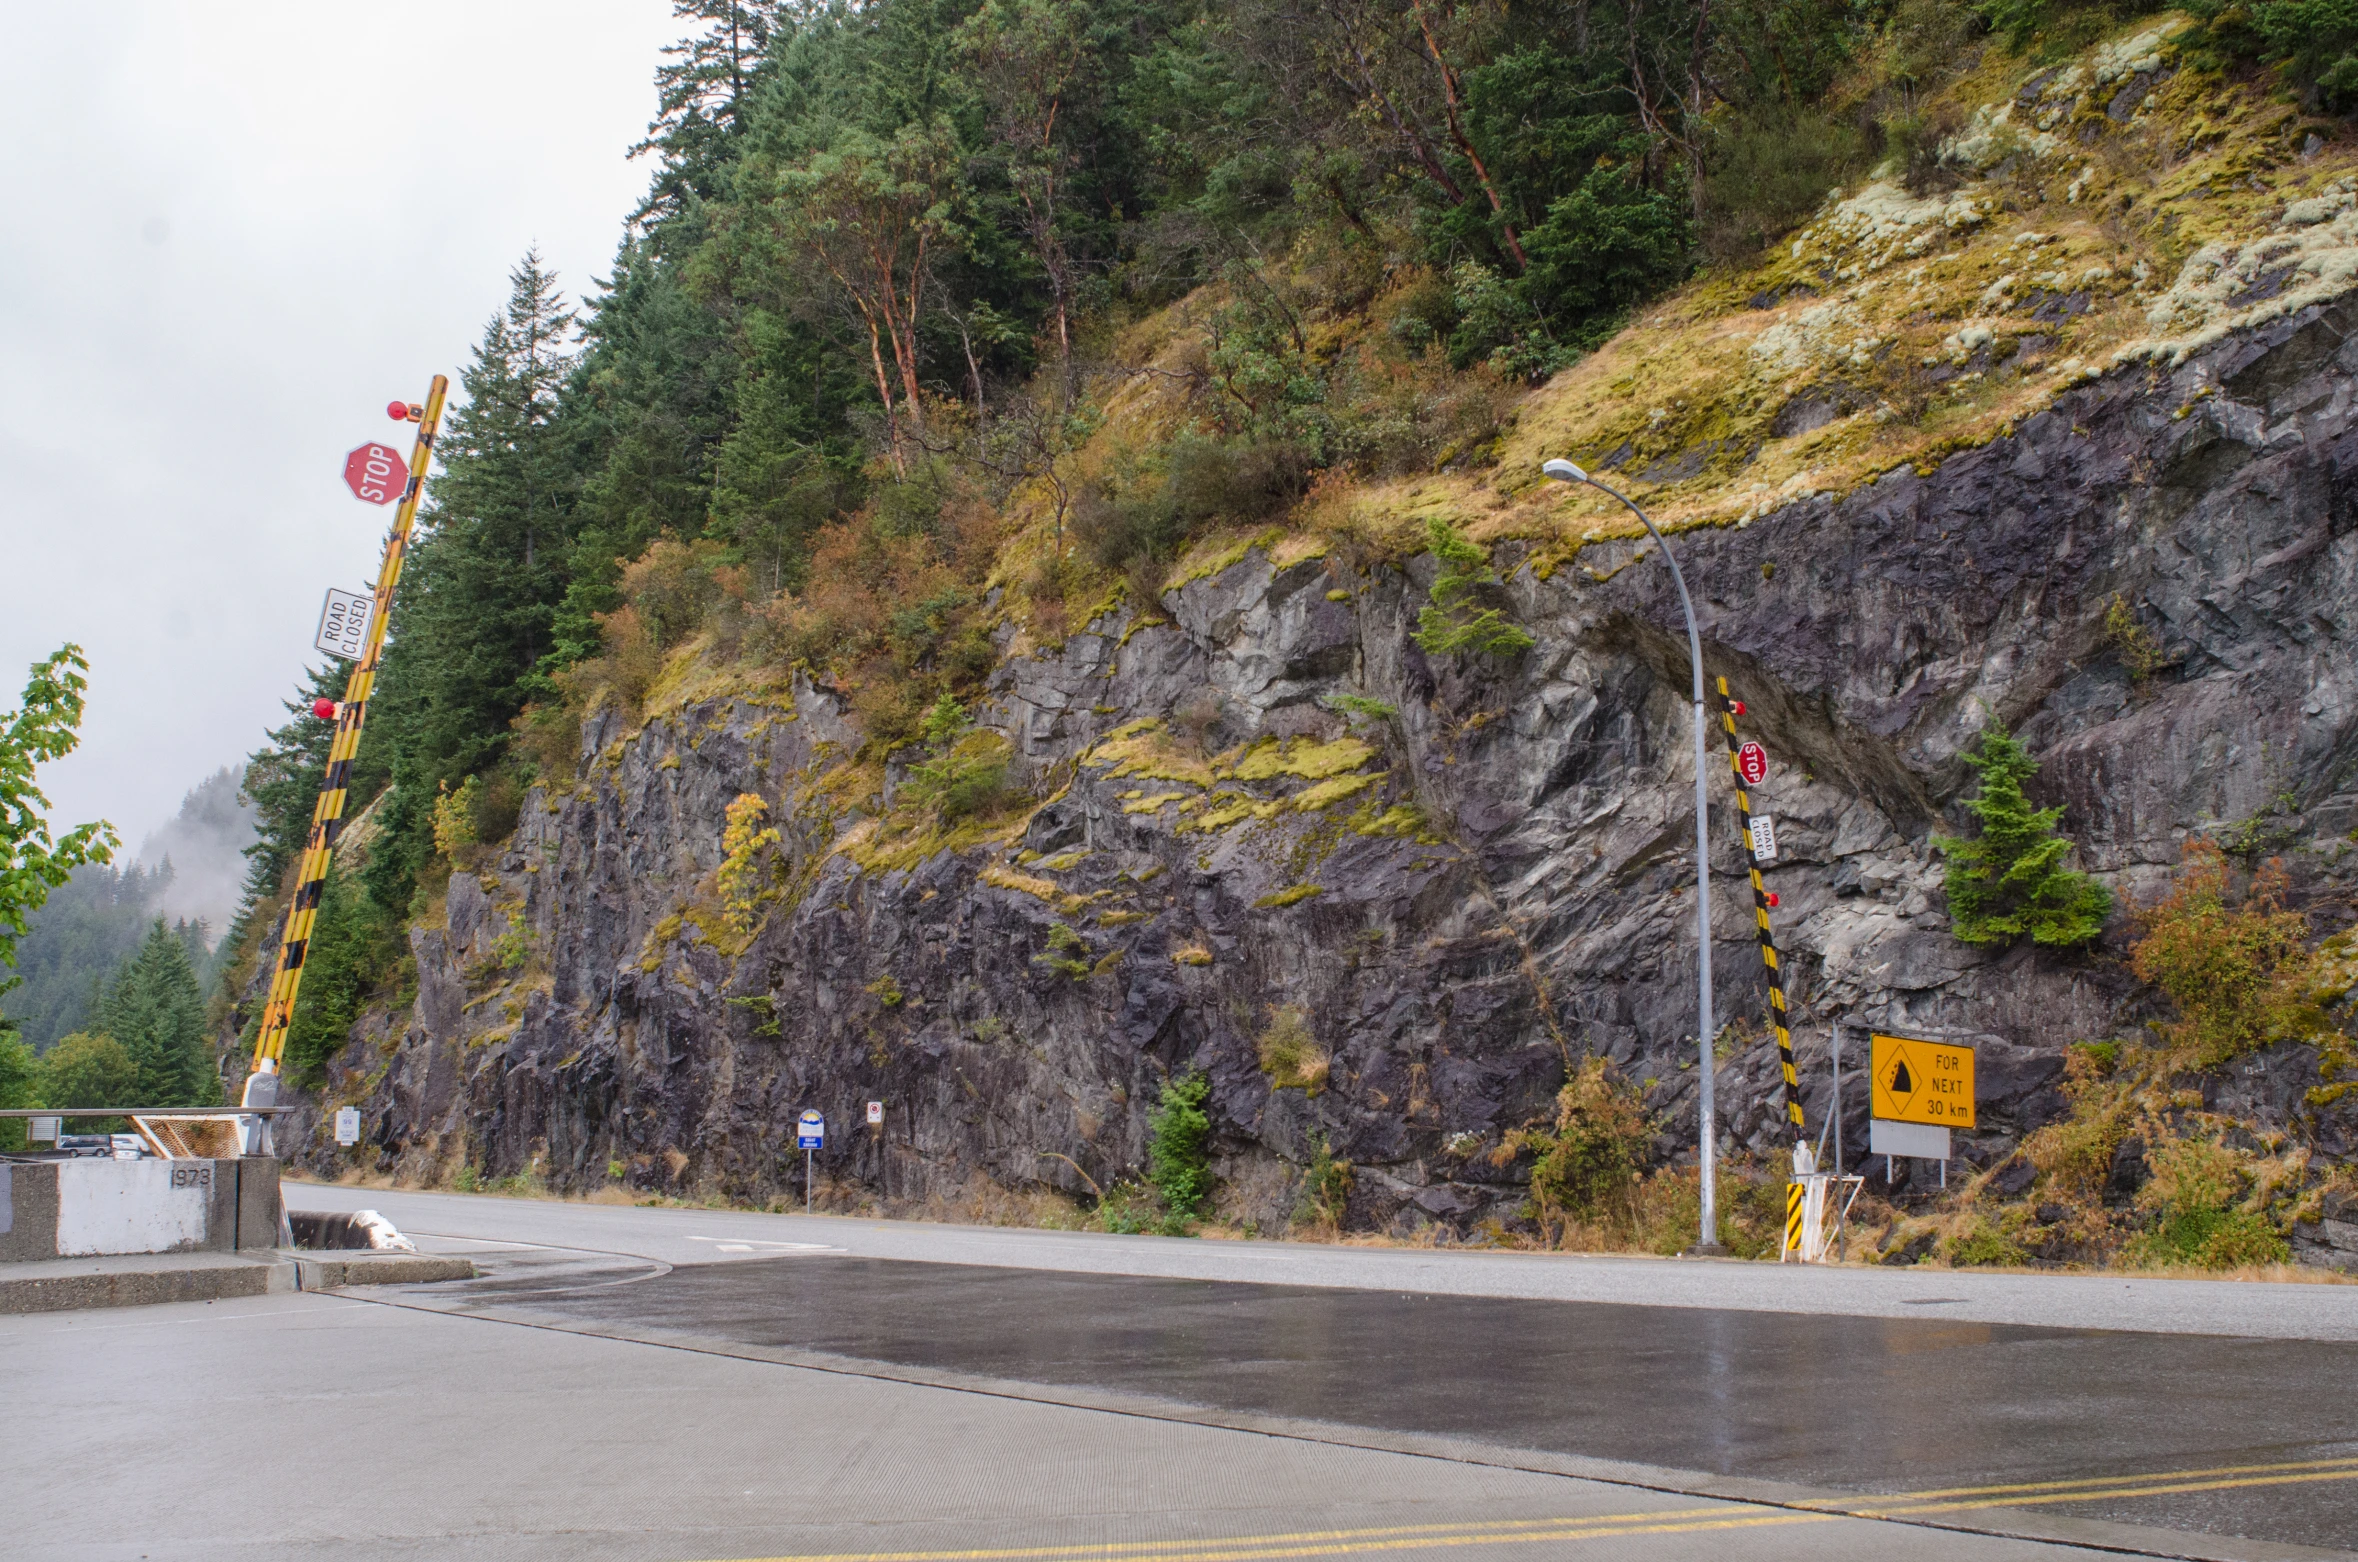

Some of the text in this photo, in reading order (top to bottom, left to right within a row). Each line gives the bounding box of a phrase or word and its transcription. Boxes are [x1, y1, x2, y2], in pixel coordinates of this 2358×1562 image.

[360, 446, 393, 501] STOP
[325, 601, 347, 641] ROAD
[342, 599, 368, 655] CLOSED
[1745, 745, 1760, 783] STOP
[1752, 819, 1764, 858] CLOSED
[1762, 822, 1772, 851] ROAD
[1936, 1054, 1959, 1071] FOR
[1932, 1078, 1962, 1095] NEXT
[1927, 1100, 1968, 1118] 30 km
[171, 1168, 211, 1188] 1973
